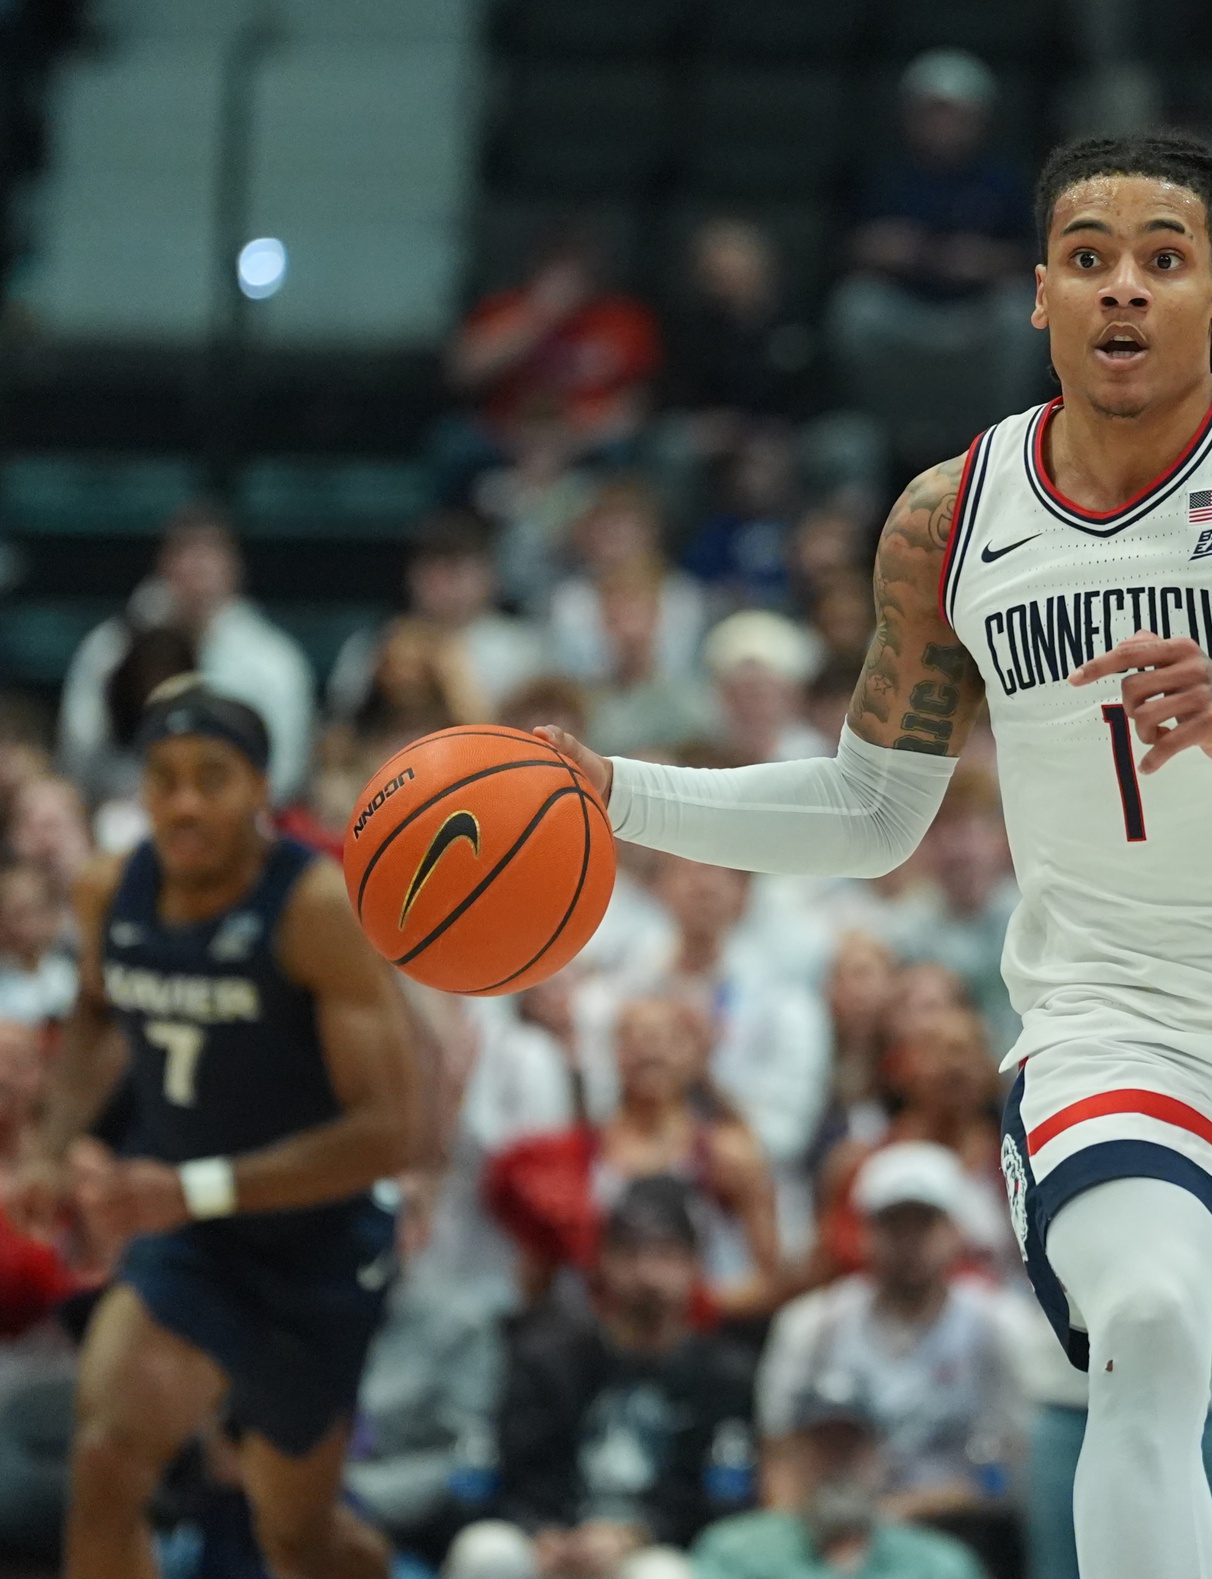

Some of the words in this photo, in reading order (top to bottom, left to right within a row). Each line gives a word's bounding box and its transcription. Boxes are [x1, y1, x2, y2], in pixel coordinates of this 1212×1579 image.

[354, 767, 415, 839] UCONN
[1101, 704, 1147, 842] 1
[145, 1022, 204, 1106] 7
